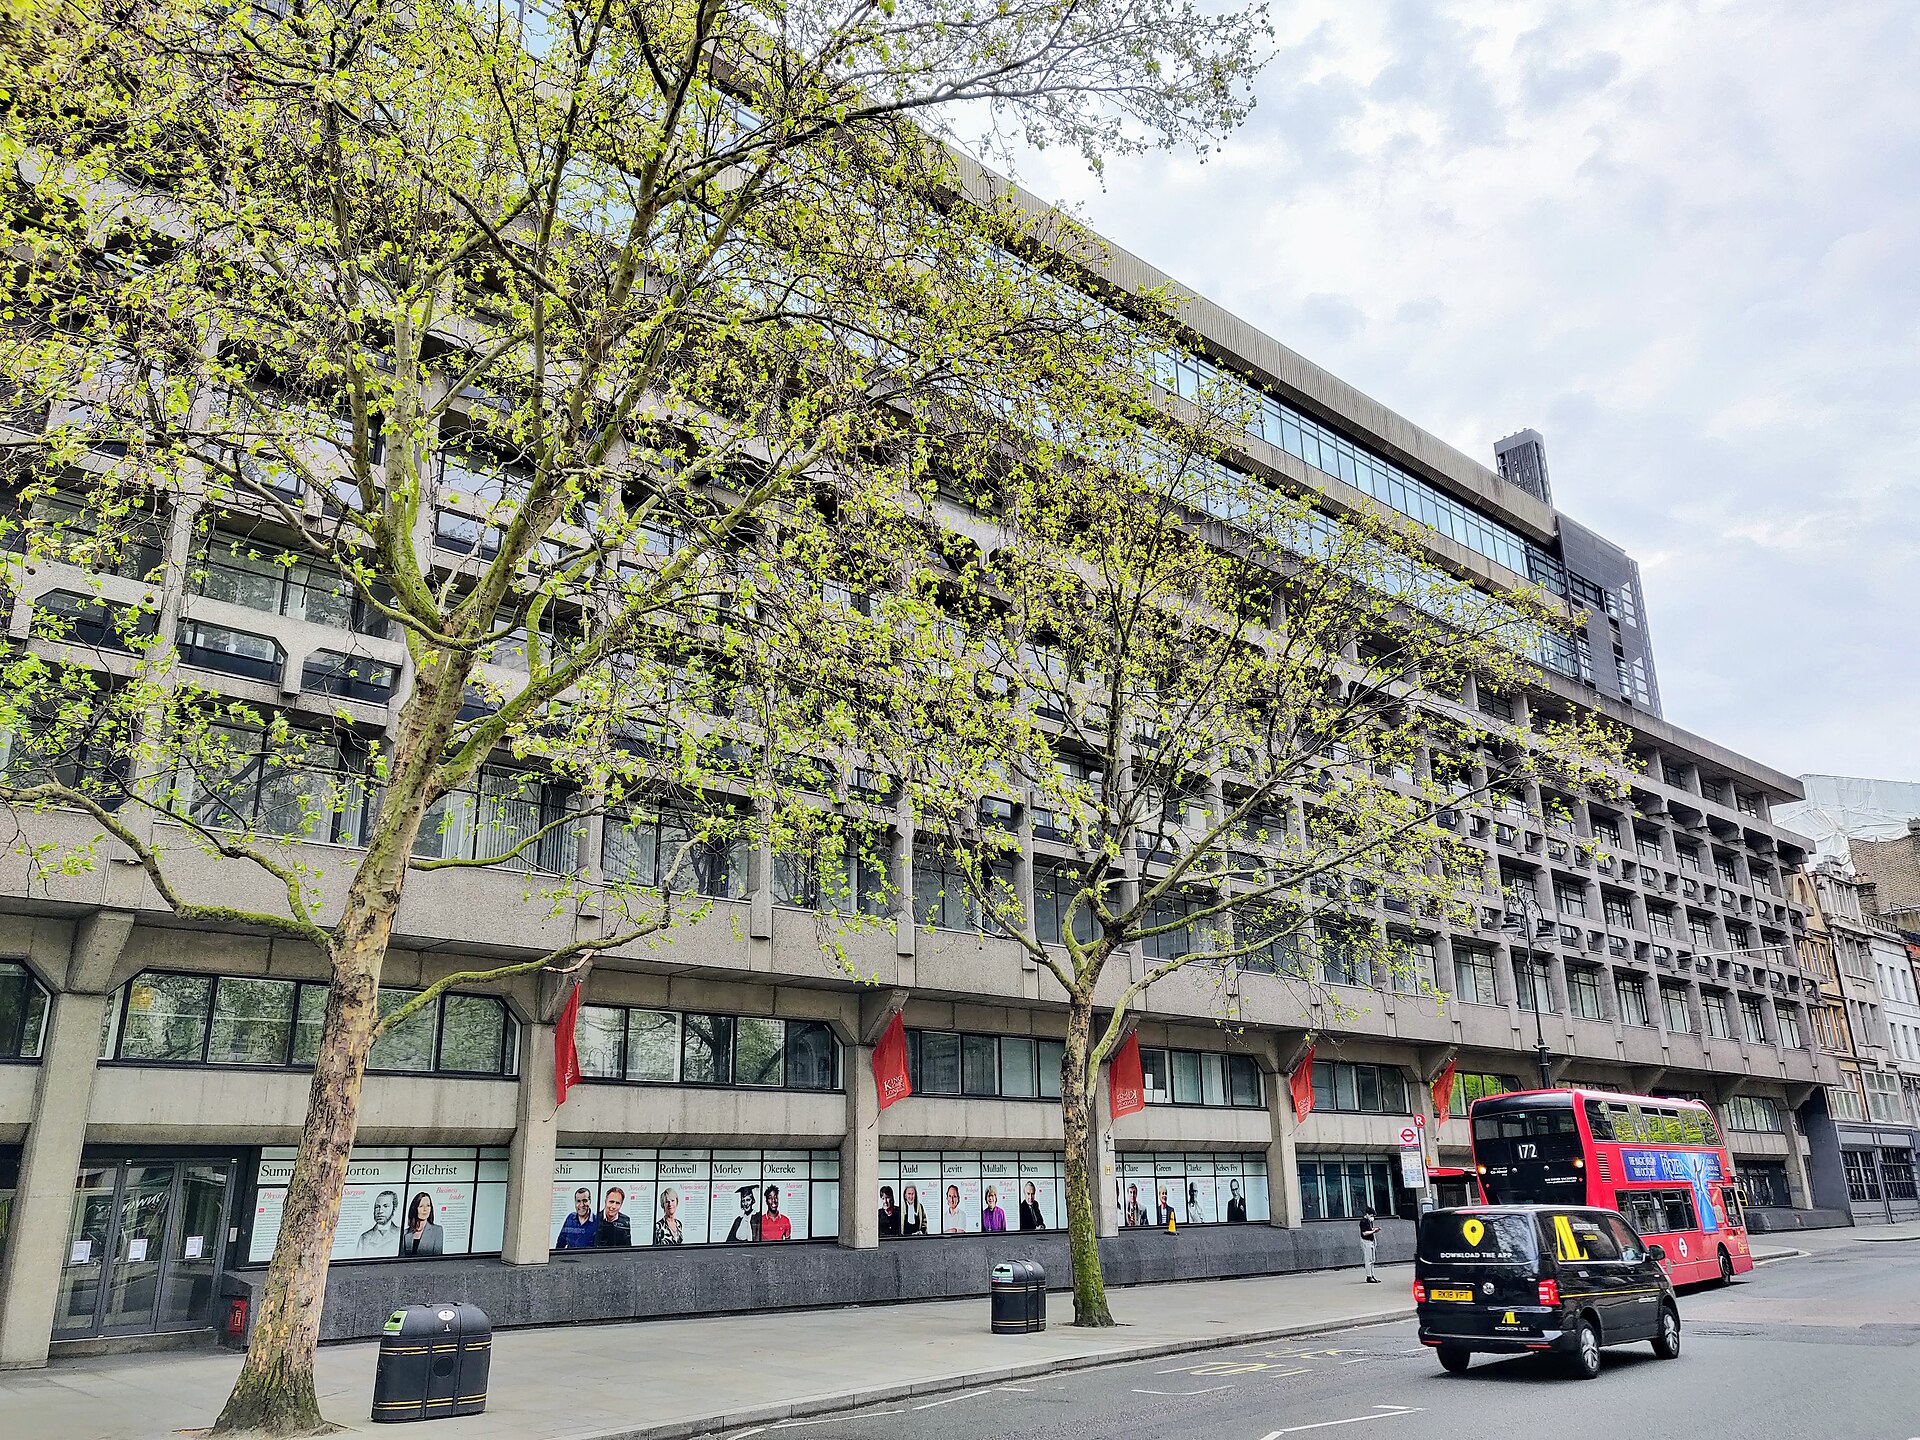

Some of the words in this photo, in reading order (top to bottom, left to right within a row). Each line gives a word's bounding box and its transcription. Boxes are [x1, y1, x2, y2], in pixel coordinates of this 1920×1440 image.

[1416, 1116, 1423, 1125] R
[1518, 1144, 1538, 1159] 172
[411, 1163, 458, 1176] Gilchrist
[554, 1163, 573, 1175] shir
[603, 1163, 640, 1175] Kureishi
[659, 1163, 697, 1174] Rothwell
[713, 1163, 743, 1175] Morley
[763, 1163, 796, 1174] Okereke
[902, 1164, 919, 1173] Auld
[943, 1163, 963, 1173] Levitt
[982, 1163, 1008, 1174] Mullally
[1020, 1163, 1039, 1173] Owen
[1156, 1163, 1172, 1172] Green
[1481, 1251, 1496, 1259] THE
